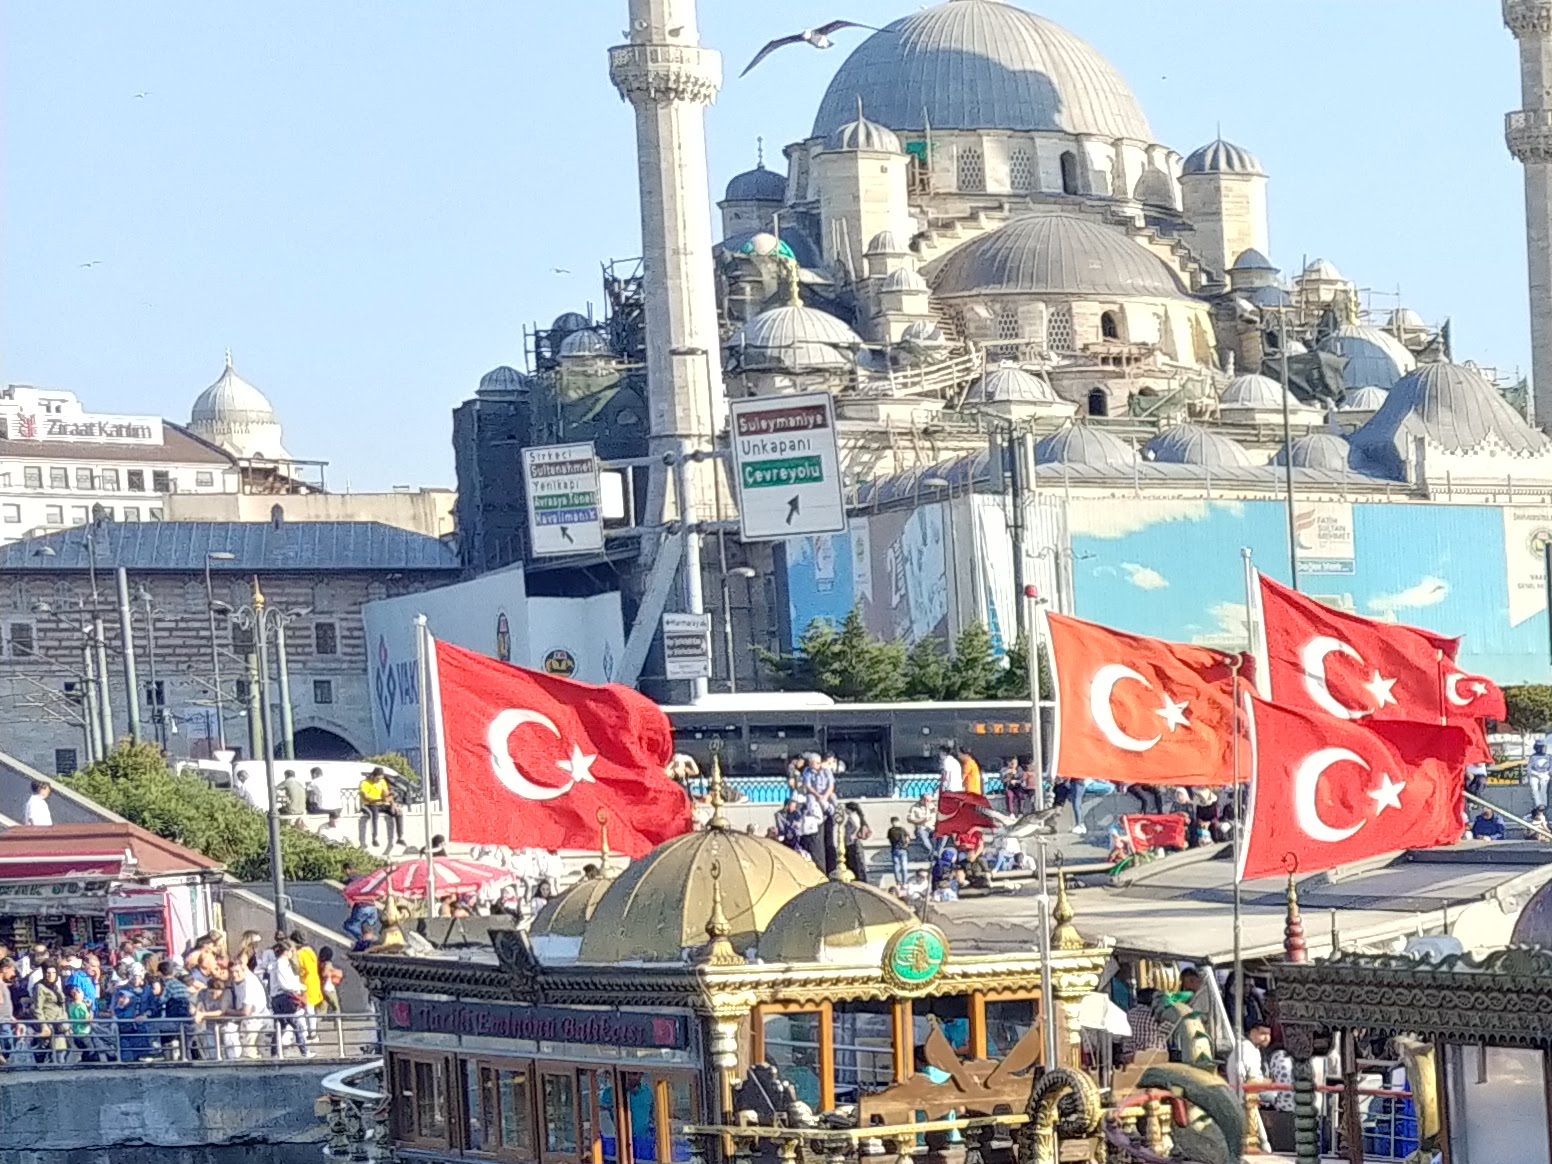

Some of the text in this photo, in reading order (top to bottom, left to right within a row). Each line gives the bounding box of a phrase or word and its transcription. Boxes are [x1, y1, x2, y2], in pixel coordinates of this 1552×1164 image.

[529, 449, 572, 463] Sirkeci
[531, 462, 593, 477] Sultanahmet
[744, 461, 821, 484] Çevreyolu
